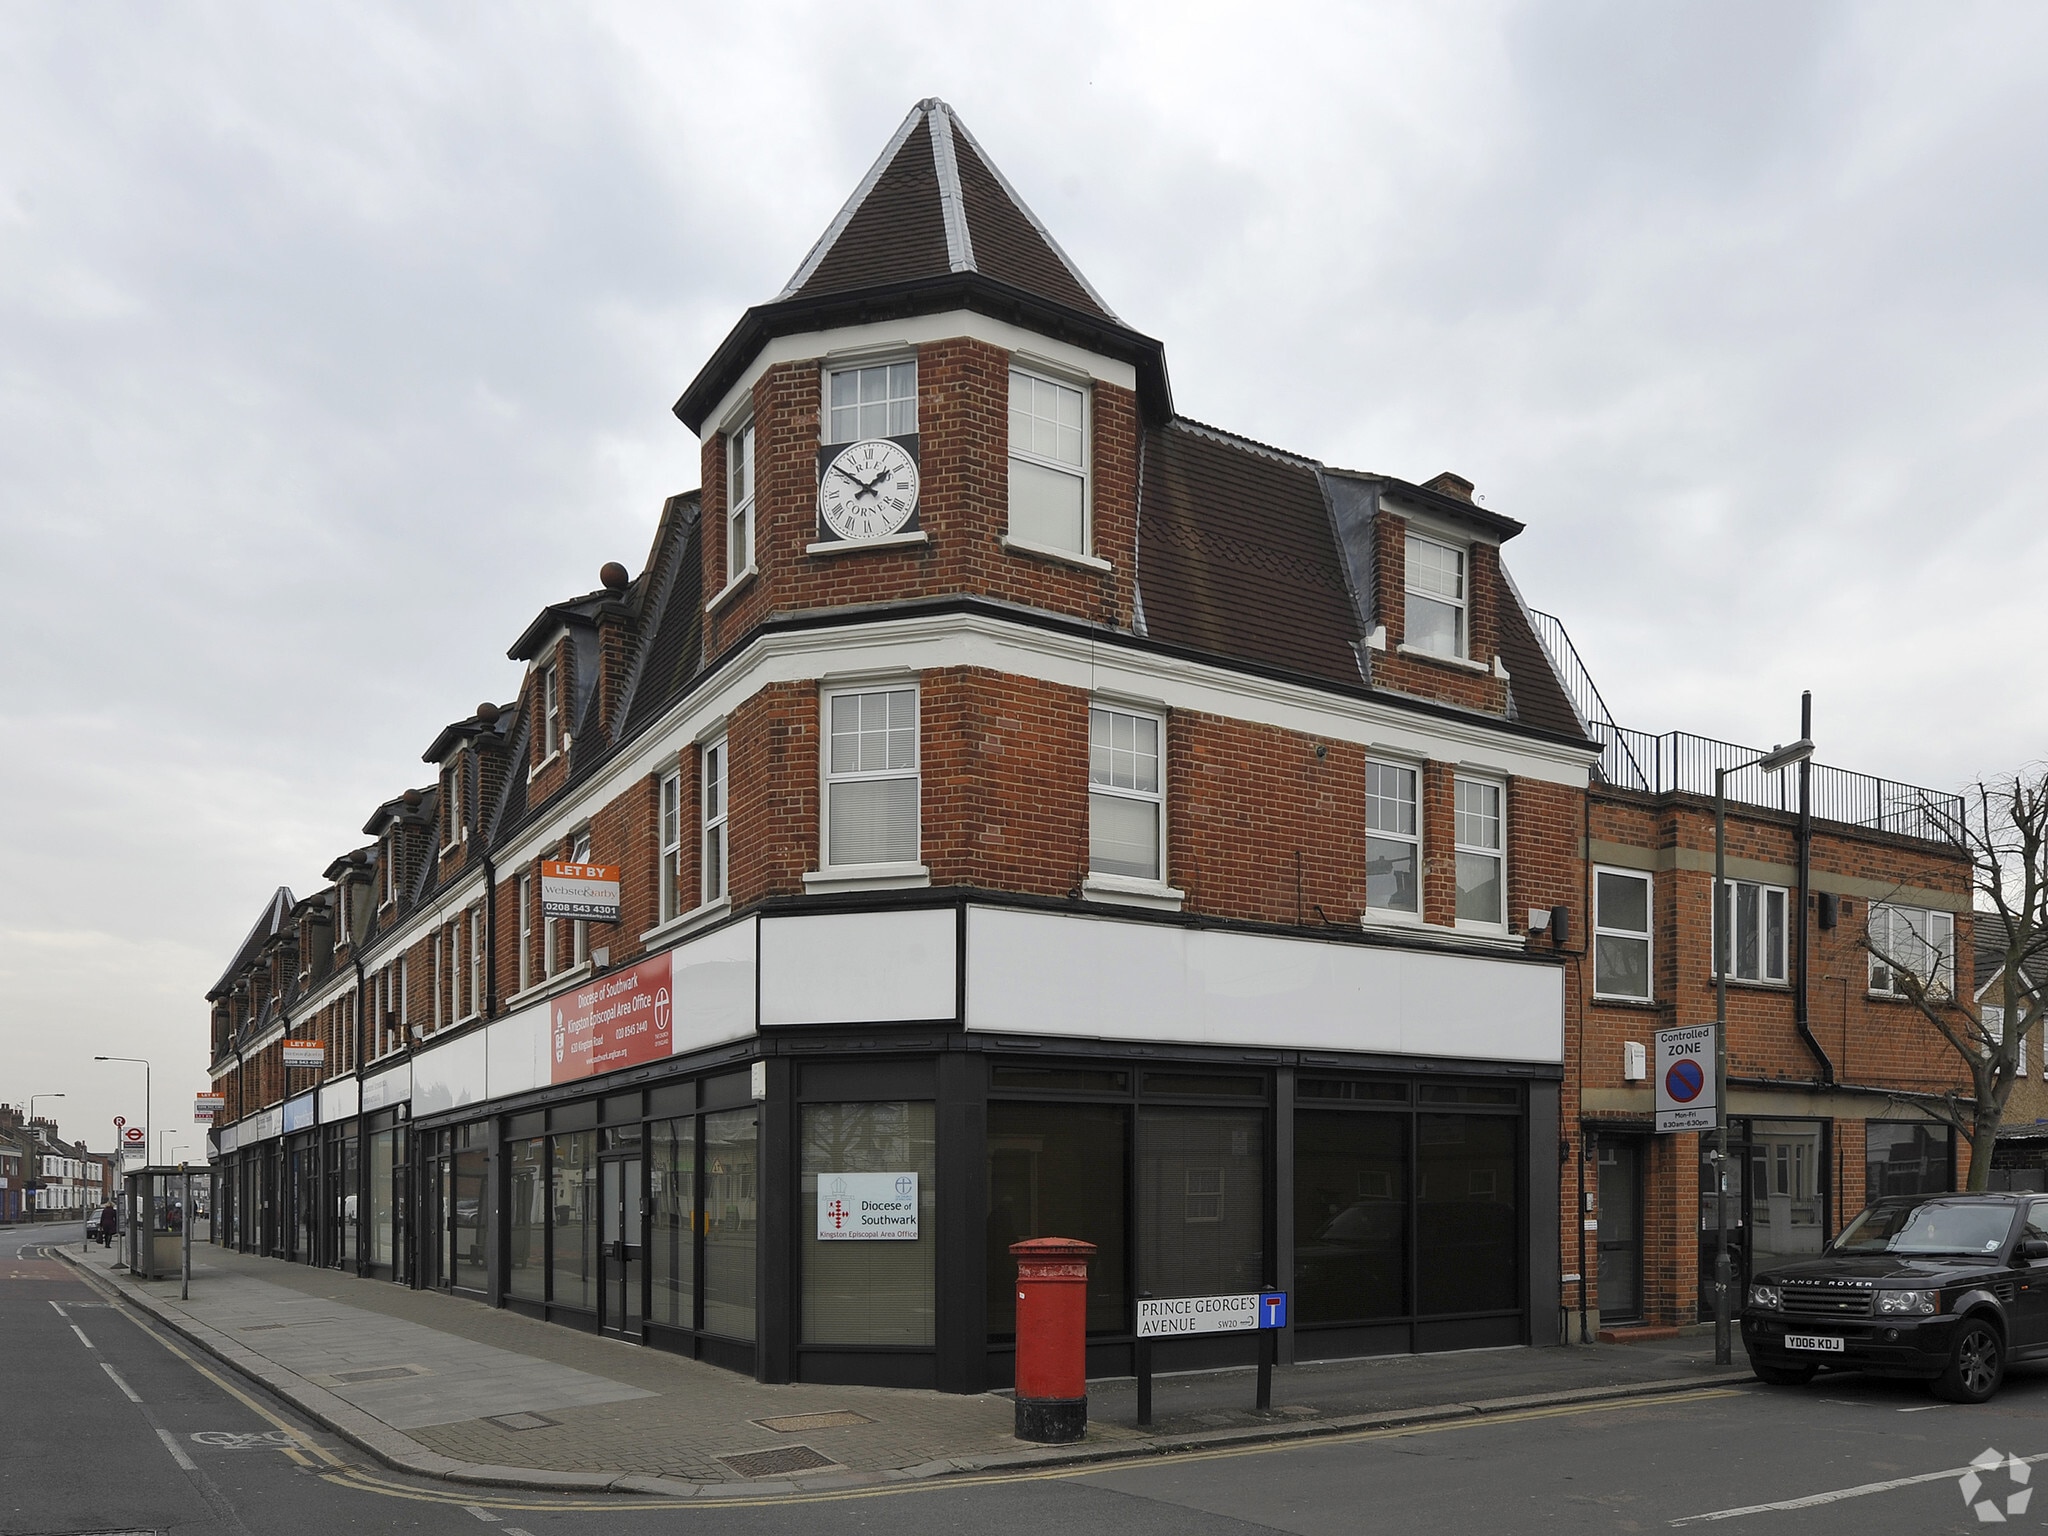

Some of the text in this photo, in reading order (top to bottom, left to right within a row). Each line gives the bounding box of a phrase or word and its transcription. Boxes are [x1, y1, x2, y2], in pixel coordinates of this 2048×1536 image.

[845, 496, 892, 517] CORNER
[556, 864, 606, 878] LET BY
[546, 903, 570, 911] 0208
[593, 906, 616, 914] 4301
[578, 972, 638, 1009] Diocese of Southwark
[568, 994, 652, 1035] Kingston Episcopal Area Office
[593, 1034, 604, 1047] Road
[1661, 1028, 1709, 1043] Controlled
[1668, 1042, 1701, 1056] ZONE
[1675, 1111, 1697, 1119] Mon-Fri
[861, 1201, 912, 1211] Diocese of
[861, 1215, 917, 1225] Southwark
[820, 1231, 847, 1239] Kingston
[849, 1231, 878, 1239] Episcopal
[1142, 1297, 1256, 1316] PRINCE GEORGE'S
[1142, 1318, 1196, 1334] AVENUE
[1218, 1319, 1238, 1329] SW20
[1818, 1338, 1839, 1350] KDJ
